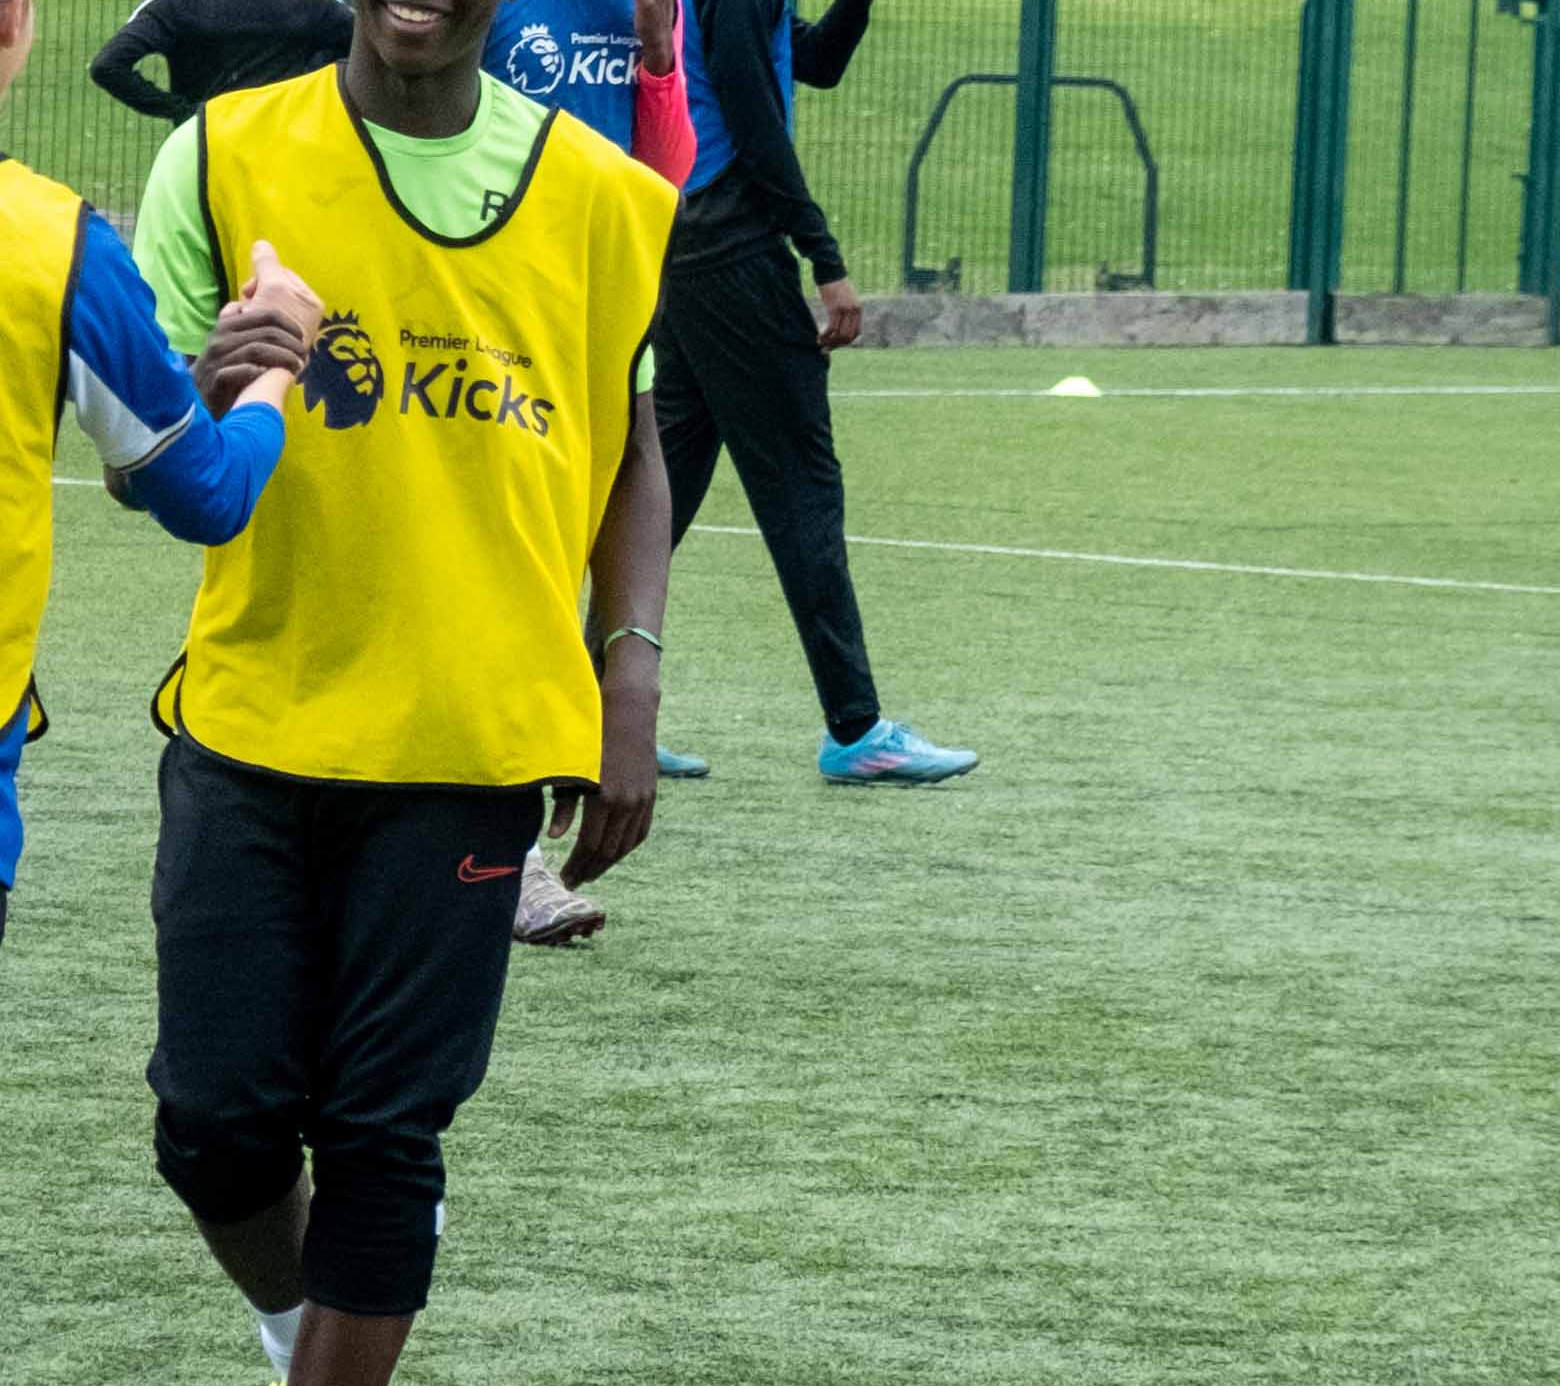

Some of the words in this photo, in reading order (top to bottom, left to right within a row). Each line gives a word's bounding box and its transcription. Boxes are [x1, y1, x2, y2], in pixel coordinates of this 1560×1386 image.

[571, 32, 607, 44] Premier
[400, 329, 469, 351] Premier
[400, 358, 555, 438] Kicks
